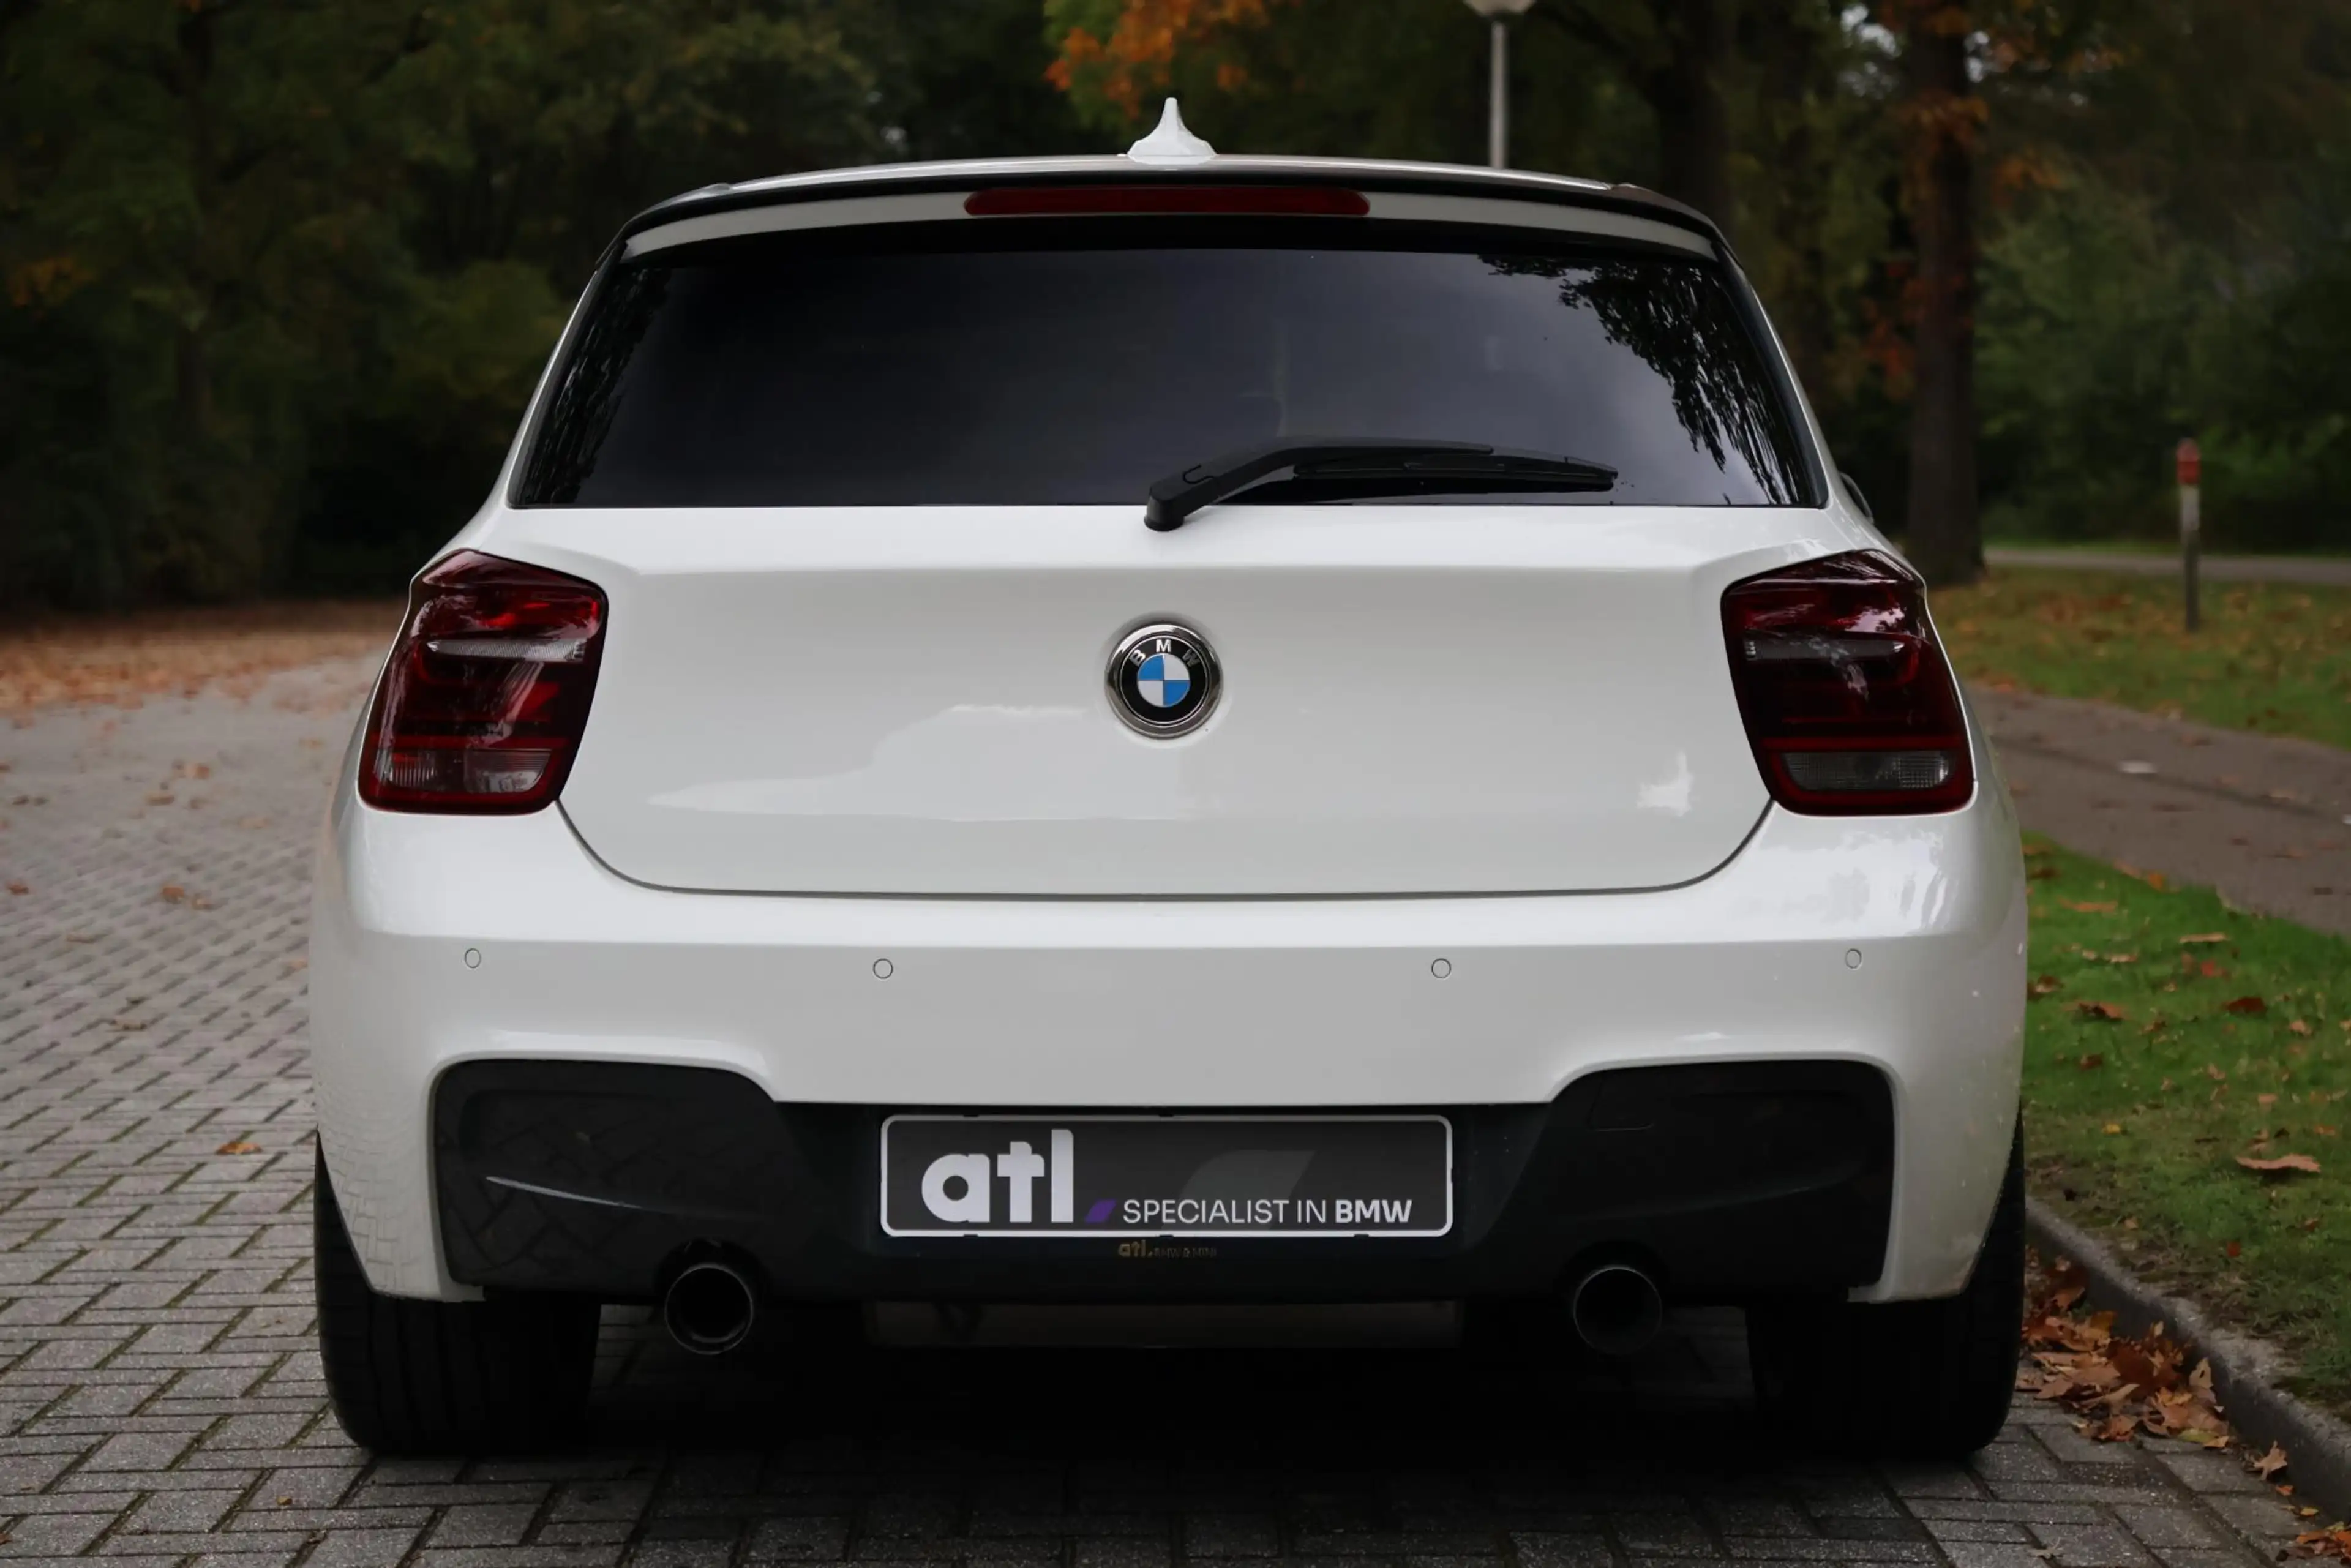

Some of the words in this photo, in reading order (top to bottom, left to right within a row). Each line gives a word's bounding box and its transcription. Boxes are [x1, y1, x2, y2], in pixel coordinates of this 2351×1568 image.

[1130, 639, 1201, 667] BMW
[922, 1130, 1073, 1223] atl
[1123, 1199, 1290, 1224] SPECIALIST
[1297, 1200, 1326, 1223] IN
[1335, 1199, 1412, 1223] BMW
